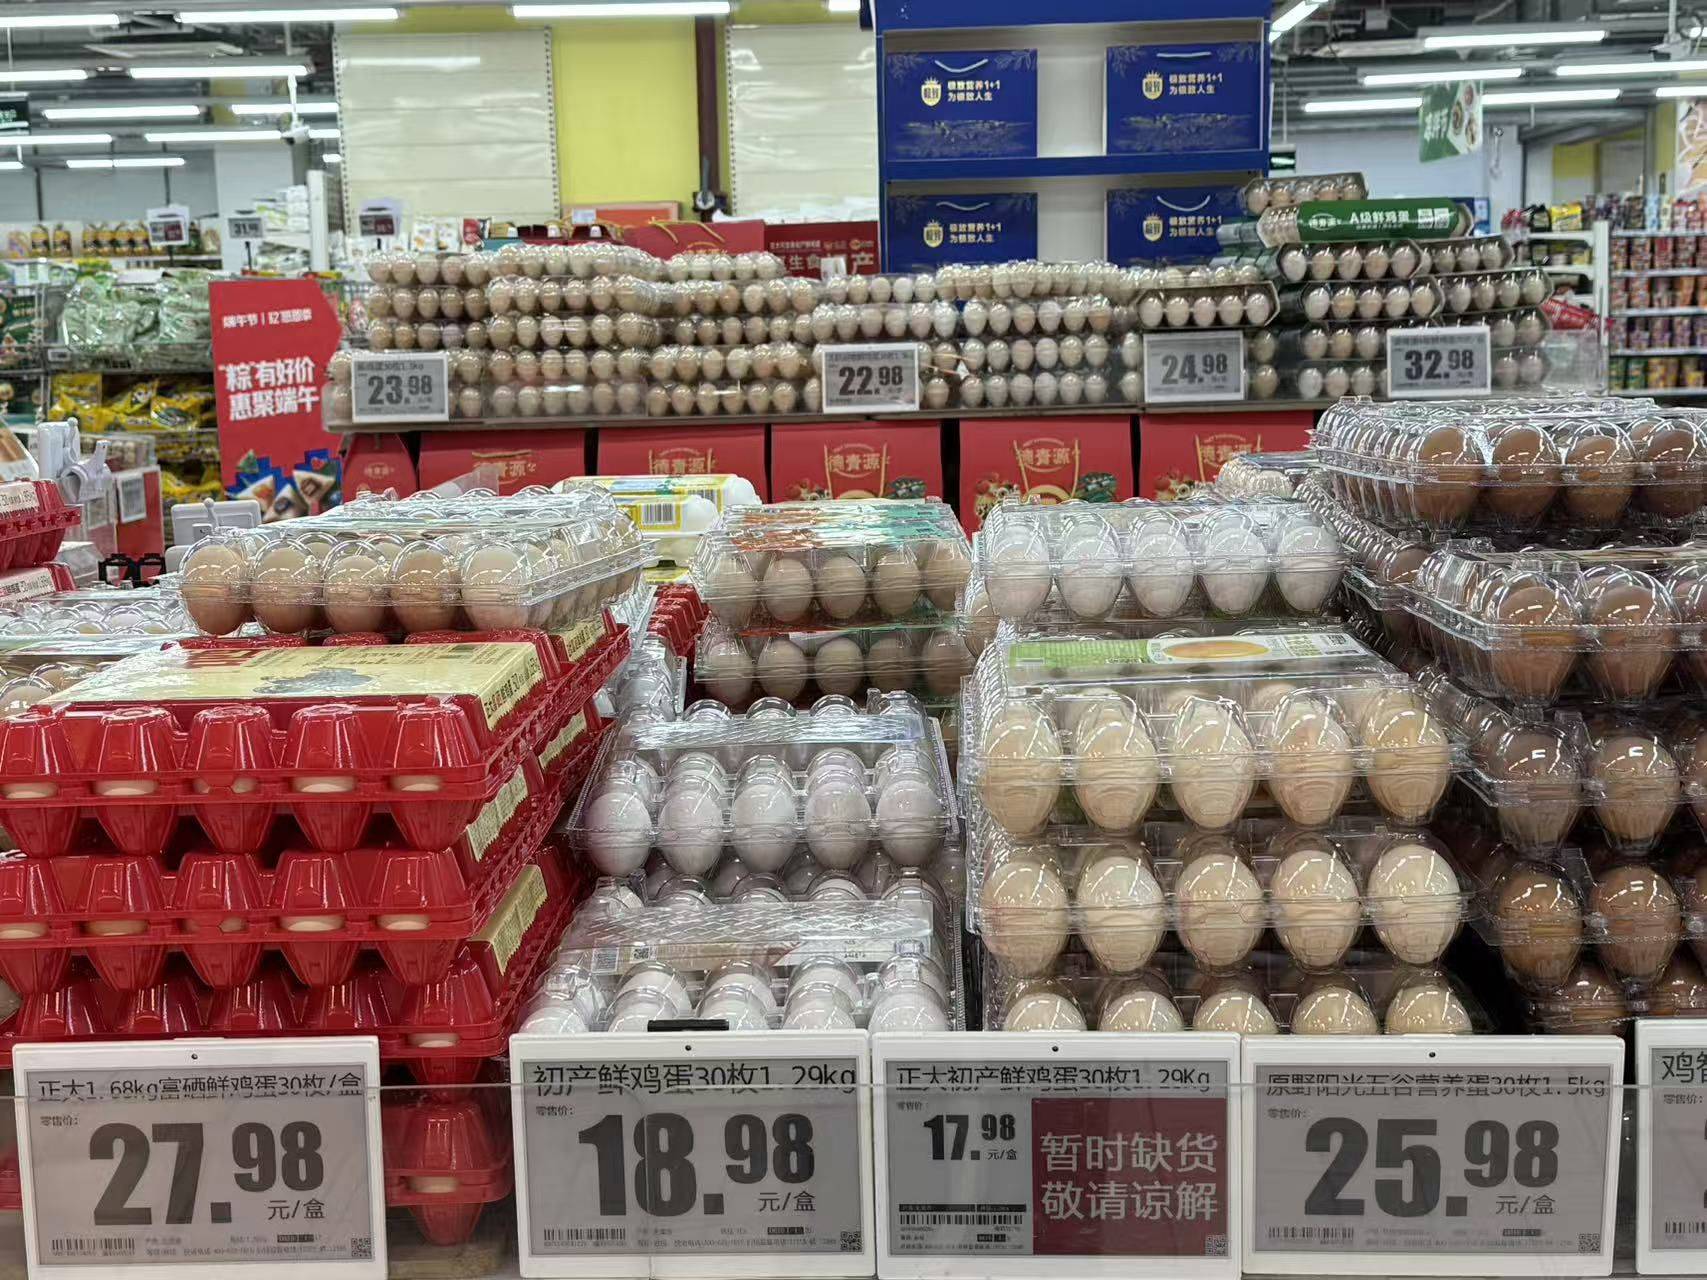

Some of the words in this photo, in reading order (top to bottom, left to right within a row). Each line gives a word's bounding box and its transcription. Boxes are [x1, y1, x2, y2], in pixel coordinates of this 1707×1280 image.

[839, 366, 903, 396] 22.98
[1161, 352, 1228, 385] 24.98
[1405, 349, 1474, 380] 32.98
[229, 386, 320, 421] 惠聚端午
[368, 375, 432, 405] 23.98
[923, 1114, 1016, 1160] 17.98
[1040, 1132, 1219, 1174] 暂时缺货
[578, 1112, 816, 1217] 18.98
[986, 1149, 1018, 1161] 元/盒
[1304, 1117, 1560, 1218] 25.98
[88, 1121, 325, 1226] 27.98
[267, 1198, 326, 1221] 元/盒
[757, 1191, 817, 1213] 元/盒
[1040, 1181, 1219, 1222] 敬请谅解
[1495, 1194, 1557, 1216] 元/盒
